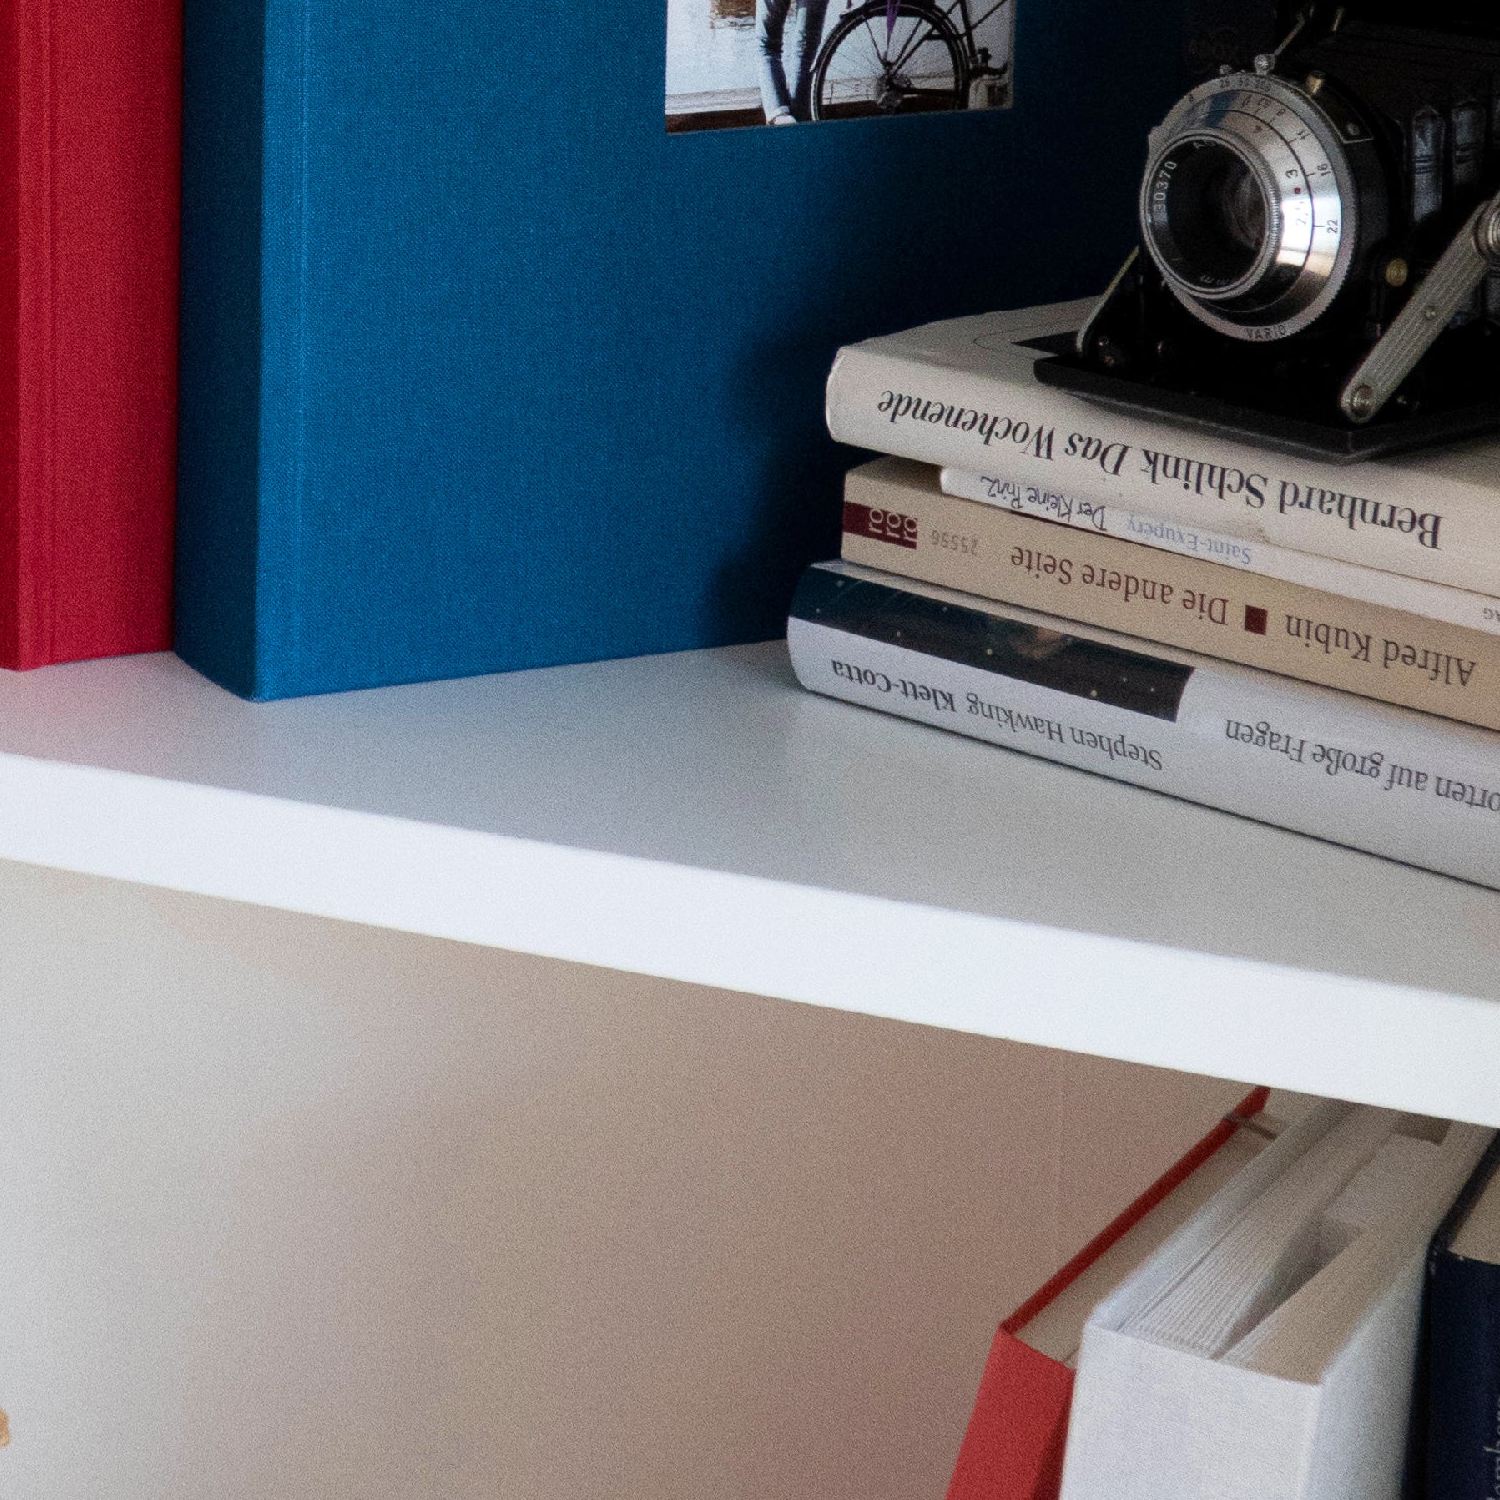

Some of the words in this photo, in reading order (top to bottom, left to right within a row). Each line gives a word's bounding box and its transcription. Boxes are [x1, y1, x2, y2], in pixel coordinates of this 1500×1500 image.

[1326, 219, 1339, 235] 22
[1245, 324, 1287, 340] VARIO
[876, 389, 1056, 462] Wochenende
[1064, 431, 1133, 477] Das
[980, 475, 1024, 510] Prinz
[1139, 447, 1270, 510] Schlink
[1027, 485, 1073, 522] Kleine
[1076, 505, 1107, 533] Der
[1278, 478, 1444, 551] Bernhard
[1010, 545, 1073, 585] Seite
[1082, 563, 1175, 612] andere
[1182, 588, 1230, 626] Die
[1284, 613, 1372, 663] Kubin
[1382, 637, 1477, 687] Alfred
[831, 659, 956, 713] Klett-Cotta
[966, 693, 1067, 745] Hawking
[1224, 719, 1306, 765] Fragen
[1068, 725, 1164, 772] Stephen
[1312, 743, 1385, 777] große
[1384, 763, 1429, 792] auf
